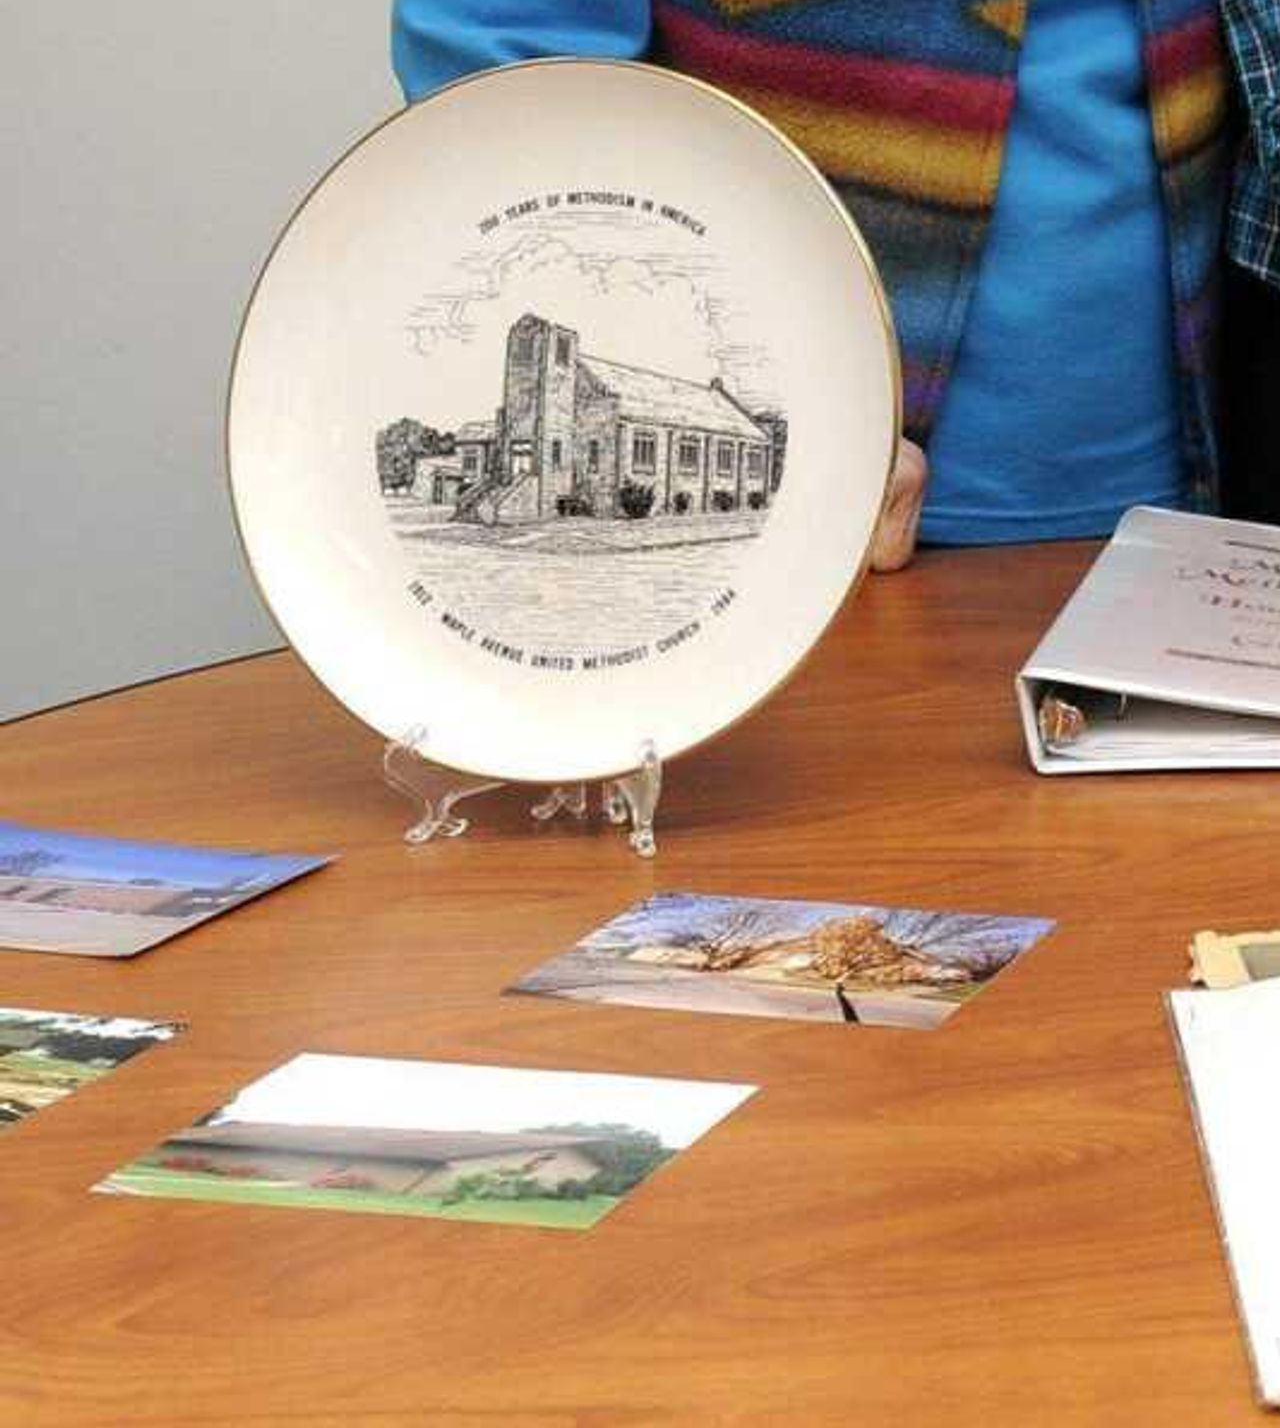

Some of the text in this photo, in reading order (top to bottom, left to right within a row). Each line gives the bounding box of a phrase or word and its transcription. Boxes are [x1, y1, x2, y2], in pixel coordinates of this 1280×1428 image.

[504, 199, 540, 223] YEARS
[546, 193, 562, 208] OF
[566, 191, 636, 208] METHODISM
[640, 199, 655, 213] IN
[659, 204, 708, 237] AMERICA
[440, 611, 476, 641] MAPLE
[479, 636, 525, 666] AVENUE
[530, 653, 574, 672] UNITED
[582, 645, 650, 671] METHODIST
[656, 620, 702, 654] CHURCH
